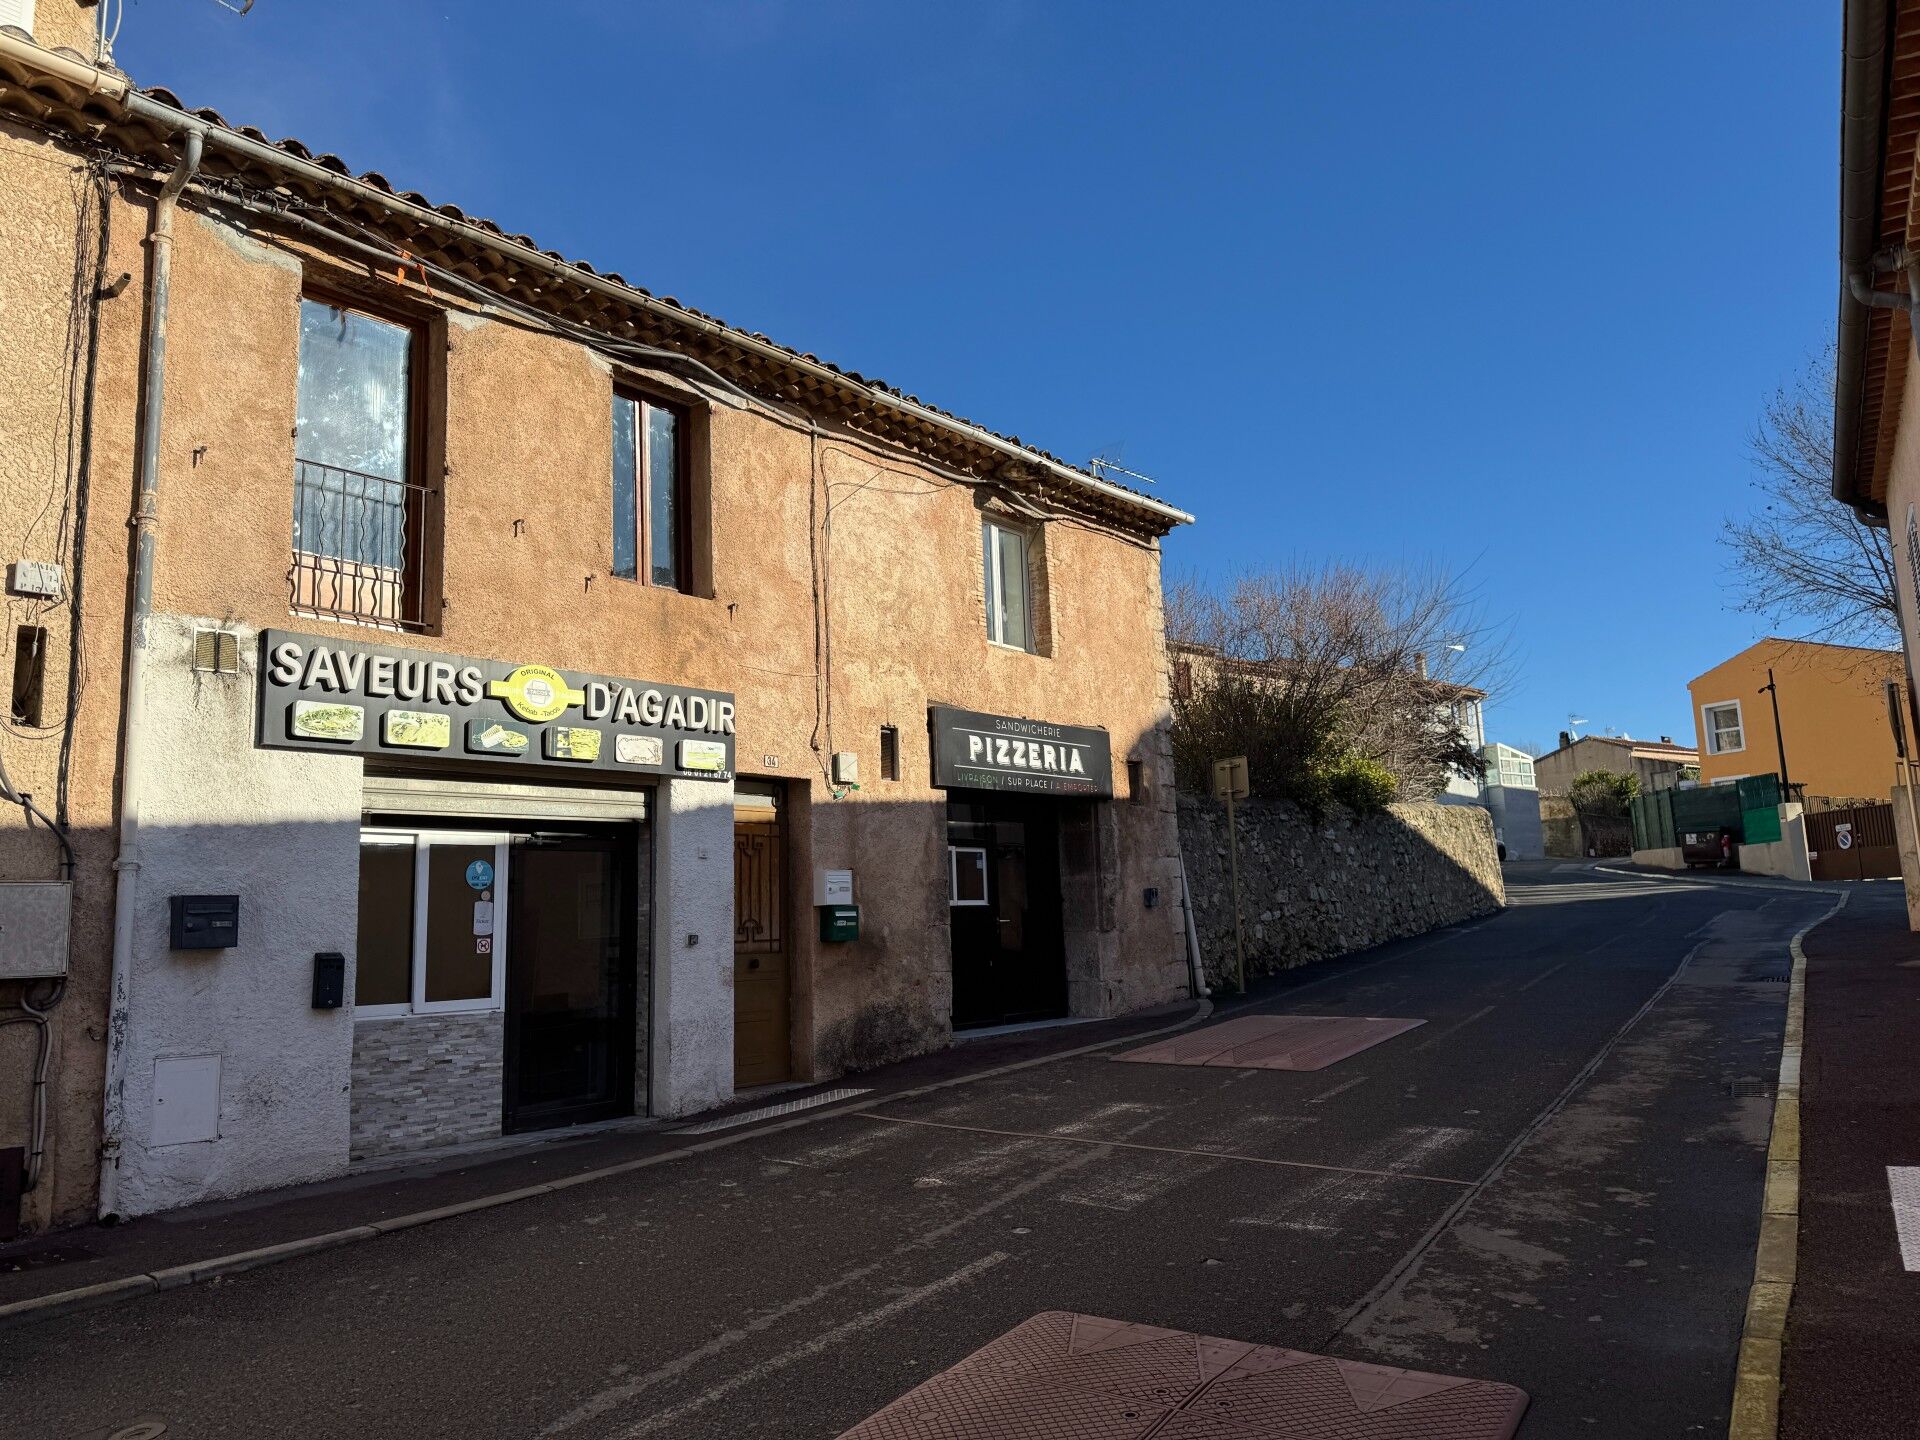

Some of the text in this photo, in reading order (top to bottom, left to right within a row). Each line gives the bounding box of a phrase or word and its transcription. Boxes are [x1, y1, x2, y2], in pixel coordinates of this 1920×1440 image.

[520, 668, 555, 680] ORIGINAL
[272, 641, 736, 733] SAVEURS D'AGADIR
[517, 701, 538, 716] Kebab
[995, 719, 1062, 738] SANDWICHERIE
[767, 756, 776, 767] 34
[968, 734, 1086, 774] PIZZERIA
[723, 771, 732, 779] 74
[957, 773, 998, 785] LIVRAISON
[1007, 776, 1022, 786] SUR
[1025, 778, 1048, 789] PLACE
[1063, 783, 1099, 793] EMPORTER
